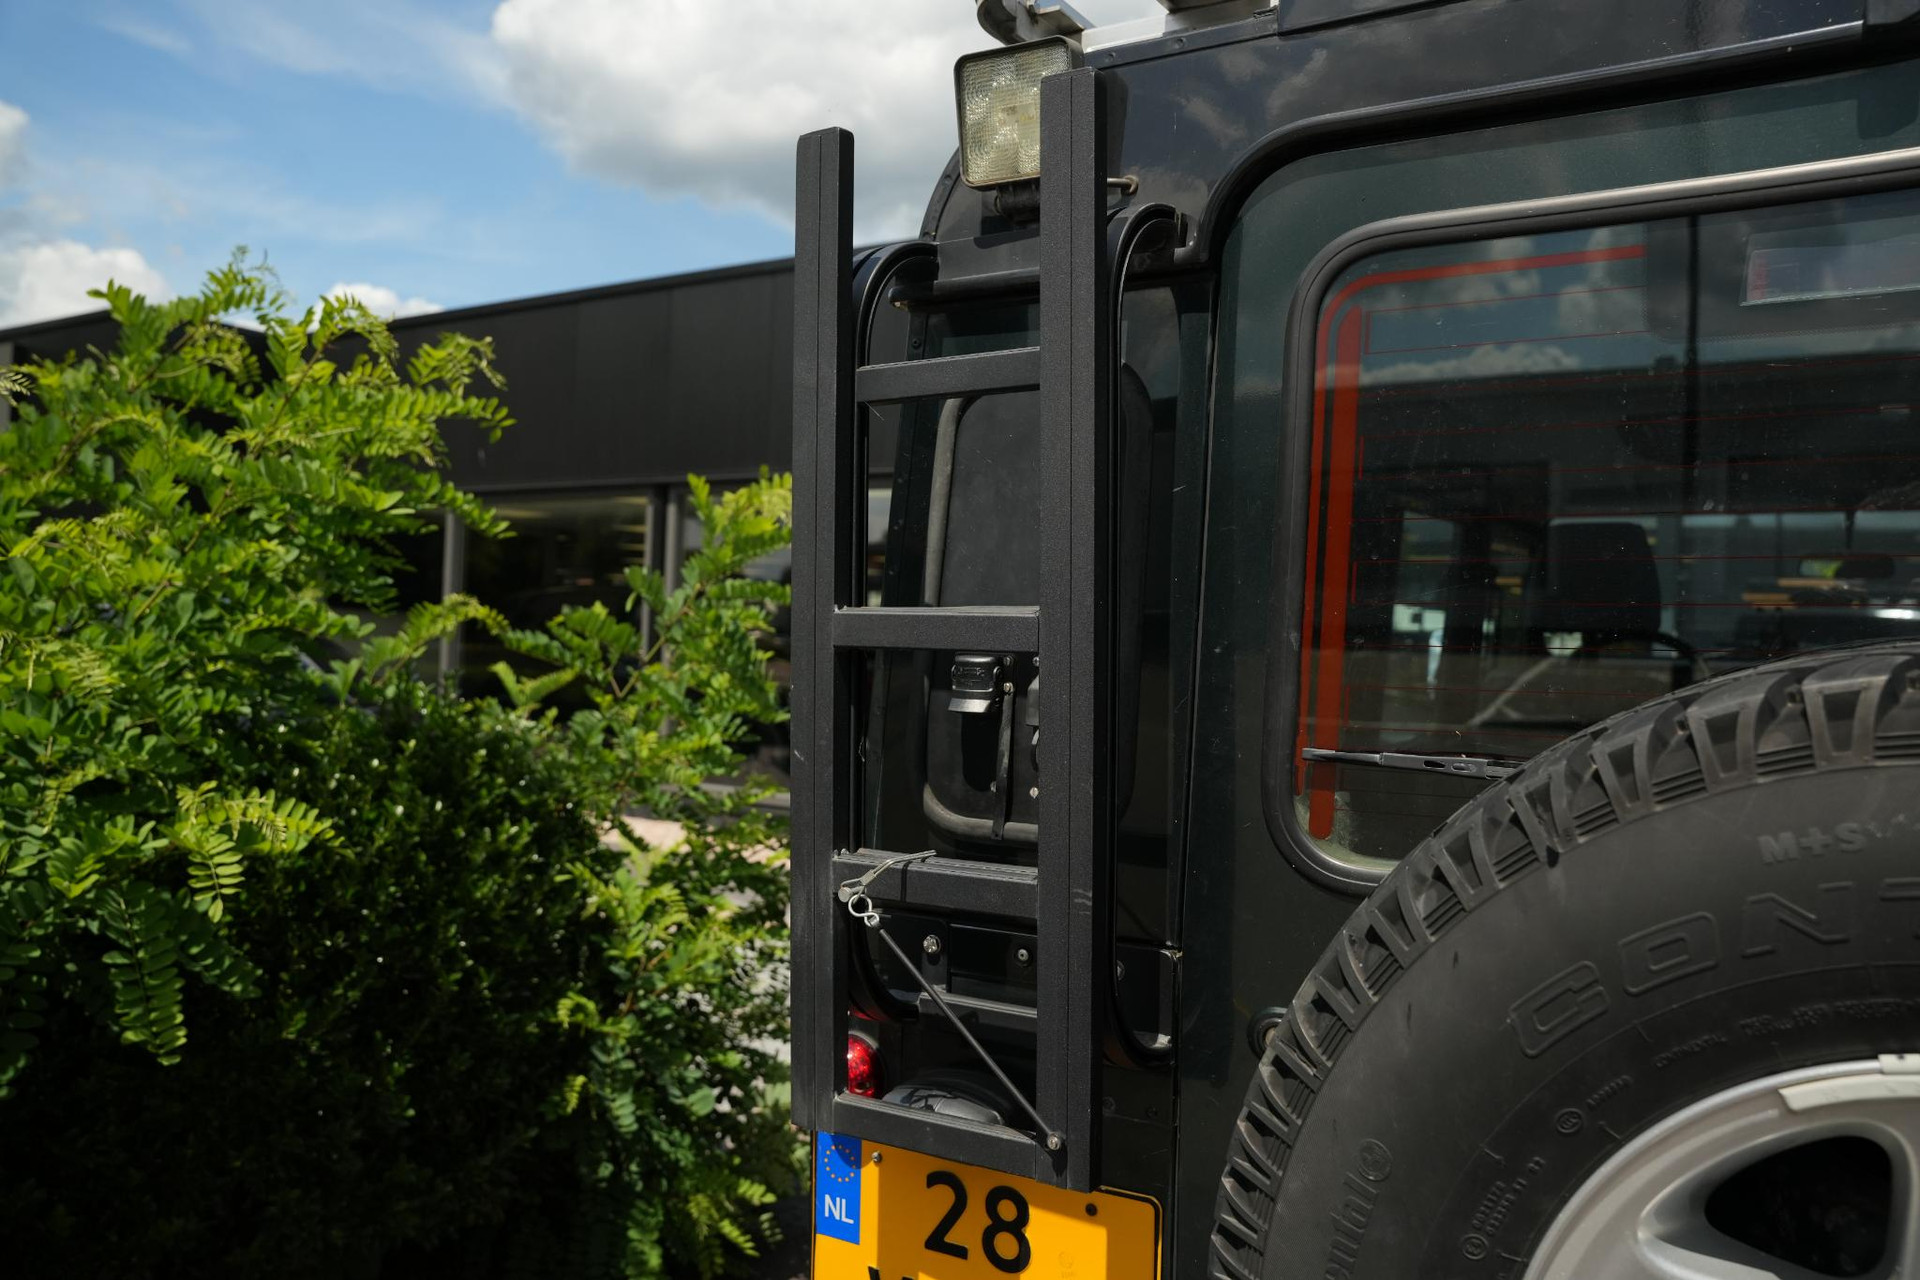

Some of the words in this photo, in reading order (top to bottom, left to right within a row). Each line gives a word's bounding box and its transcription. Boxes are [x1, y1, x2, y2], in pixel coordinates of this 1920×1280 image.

[1757, 823, 1867, 864] M+S
[824, 1194, 854, 1224] NL
[924, 1171, 1031, 1274] 28
